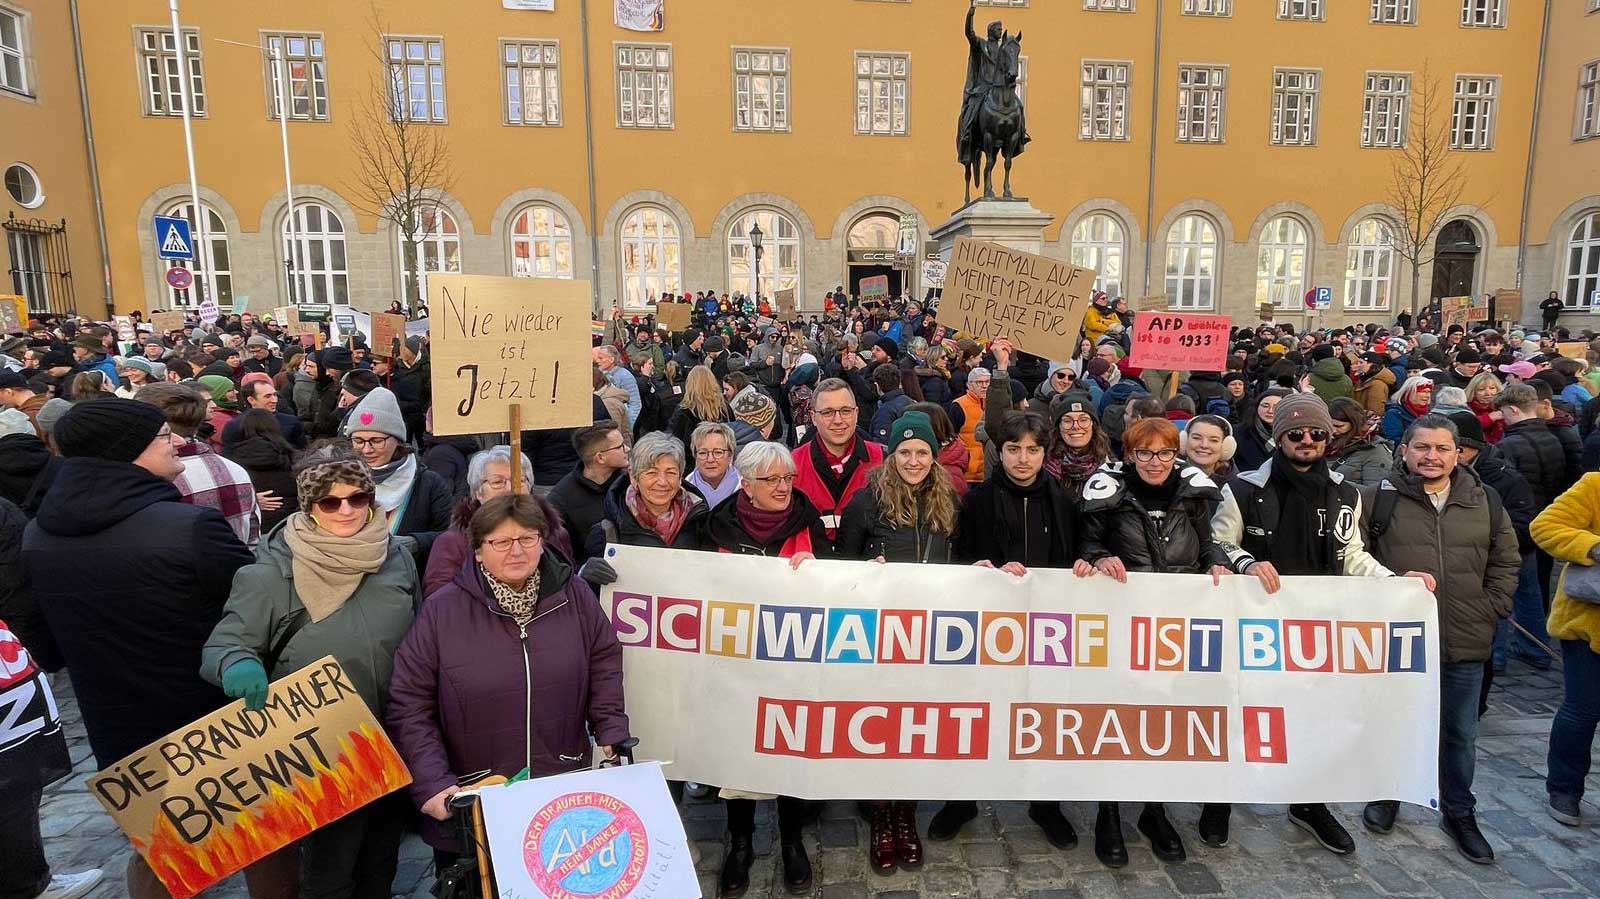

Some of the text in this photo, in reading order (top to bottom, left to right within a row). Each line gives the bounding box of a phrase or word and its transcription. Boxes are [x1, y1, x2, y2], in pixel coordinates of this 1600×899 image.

[954, 266, 1080, 312] MEINEM PLAKAT
[958, 241, 1083, 287] NICHTMAL AUF
[442, 286, 493, 340] Nie
[505, 304, 563, 333] wieder
[959, 293, 1066, 336] IST PLATZ FÜR
[1319, 288, 1329, 301] P
[500, 340, 526, 360] ist
[1178, 334, 1212, 347] 1933
[457, 364, 539, 417] Jetzt
[614, 595, 1423, 671] SCHWANDORF IST BUNT
[160, 662, 358, 777] BRANDMAUER
[761, 702, 983, 756] NICHT
[1014, 707, 1221, 758] BRAUN
[160, 725, 332, 844] BRENNT
[525, 821, 542, 851] DEN
[598, 794, 625, 814] MIST
[559, 824, 619, 874] NEIN DANKE
